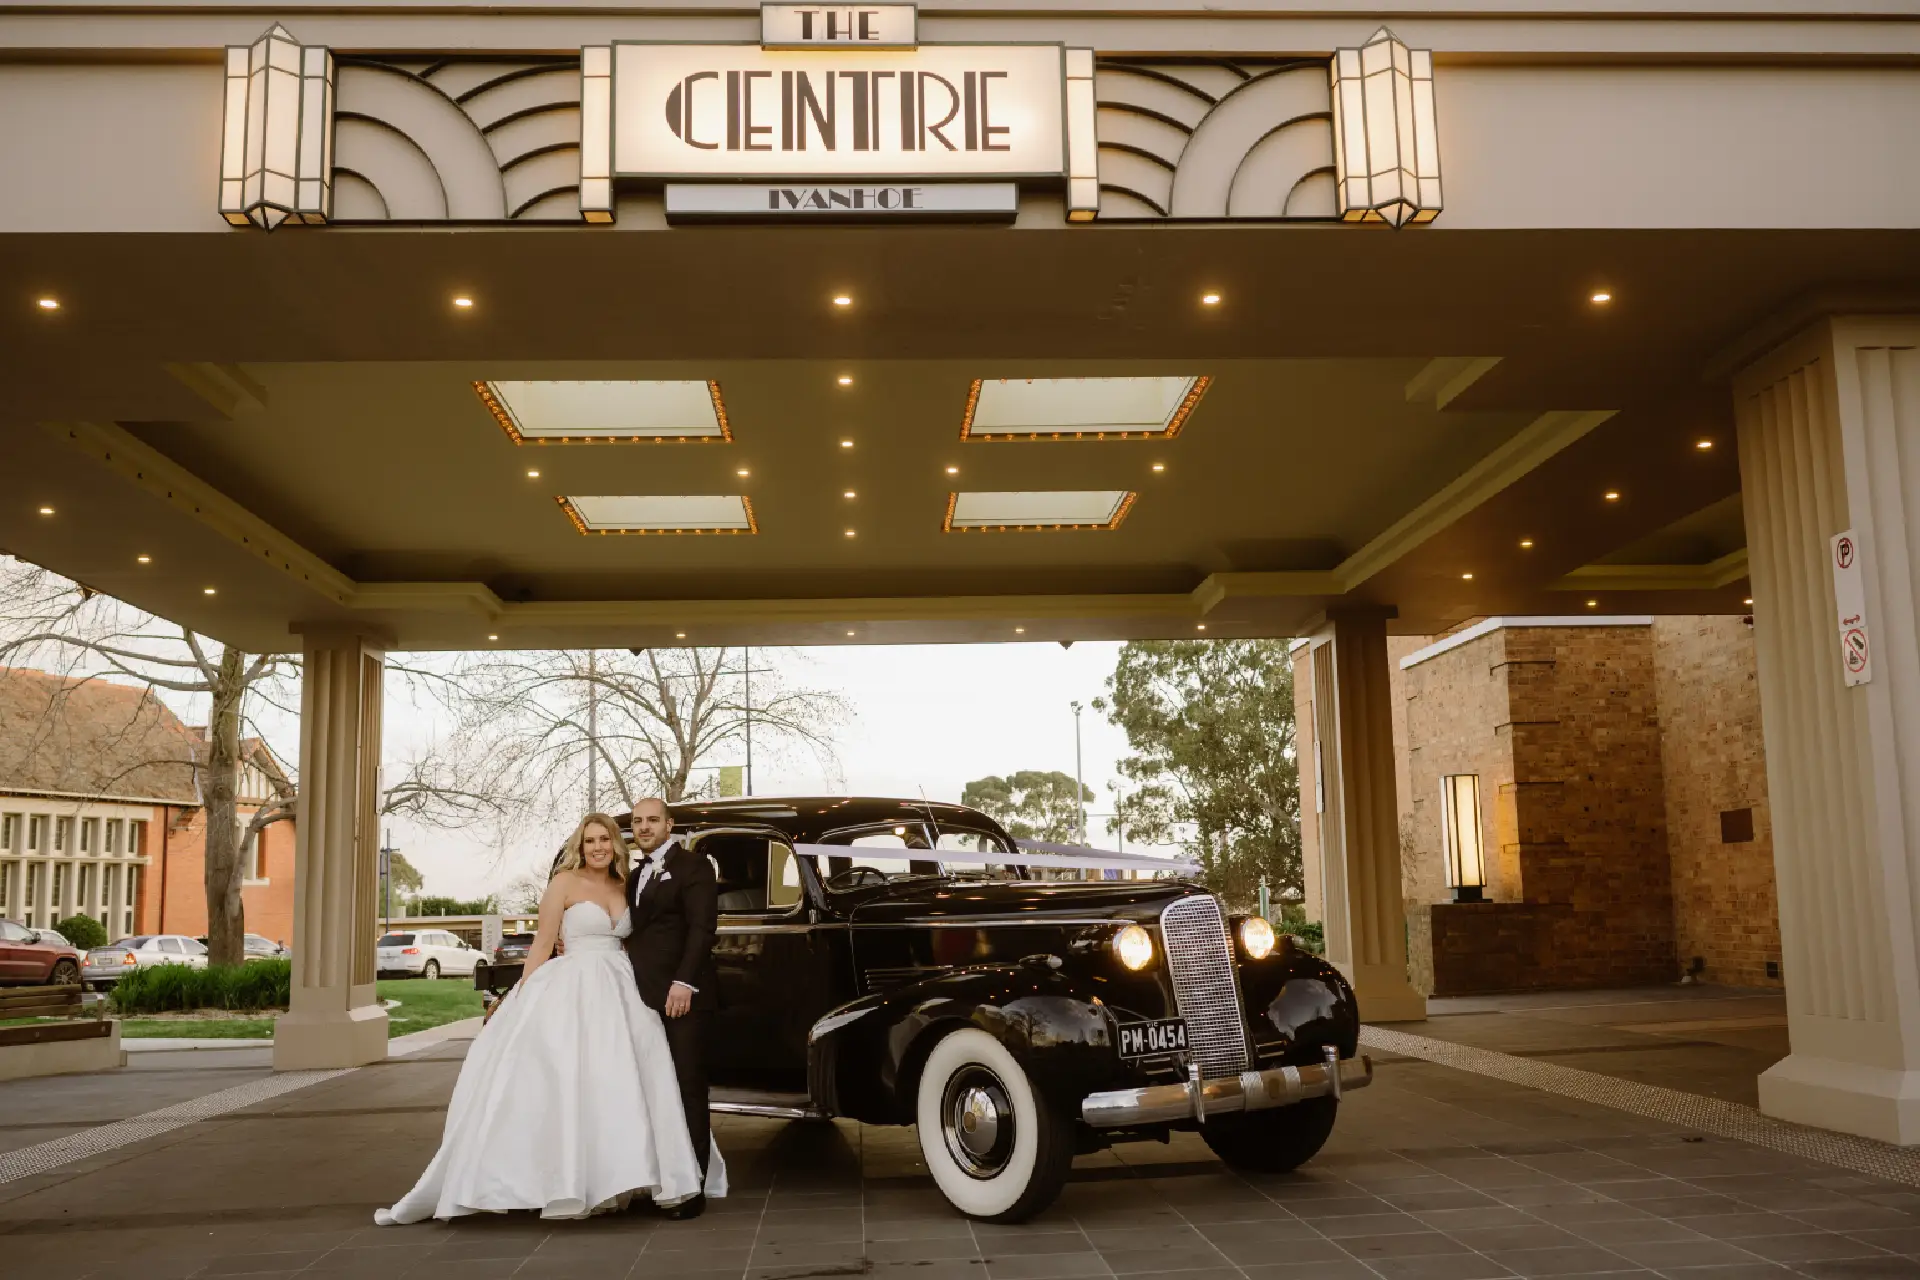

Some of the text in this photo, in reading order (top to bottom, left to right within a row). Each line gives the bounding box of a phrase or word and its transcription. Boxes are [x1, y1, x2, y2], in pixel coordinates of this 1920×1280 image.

[794, 11, 880, 40] THE
[665, 71, 1010, 151] CENTRE
[768, 188, 924, 209] IVANHOE
[1121, 1025, 1186, 1053] PM-0454
